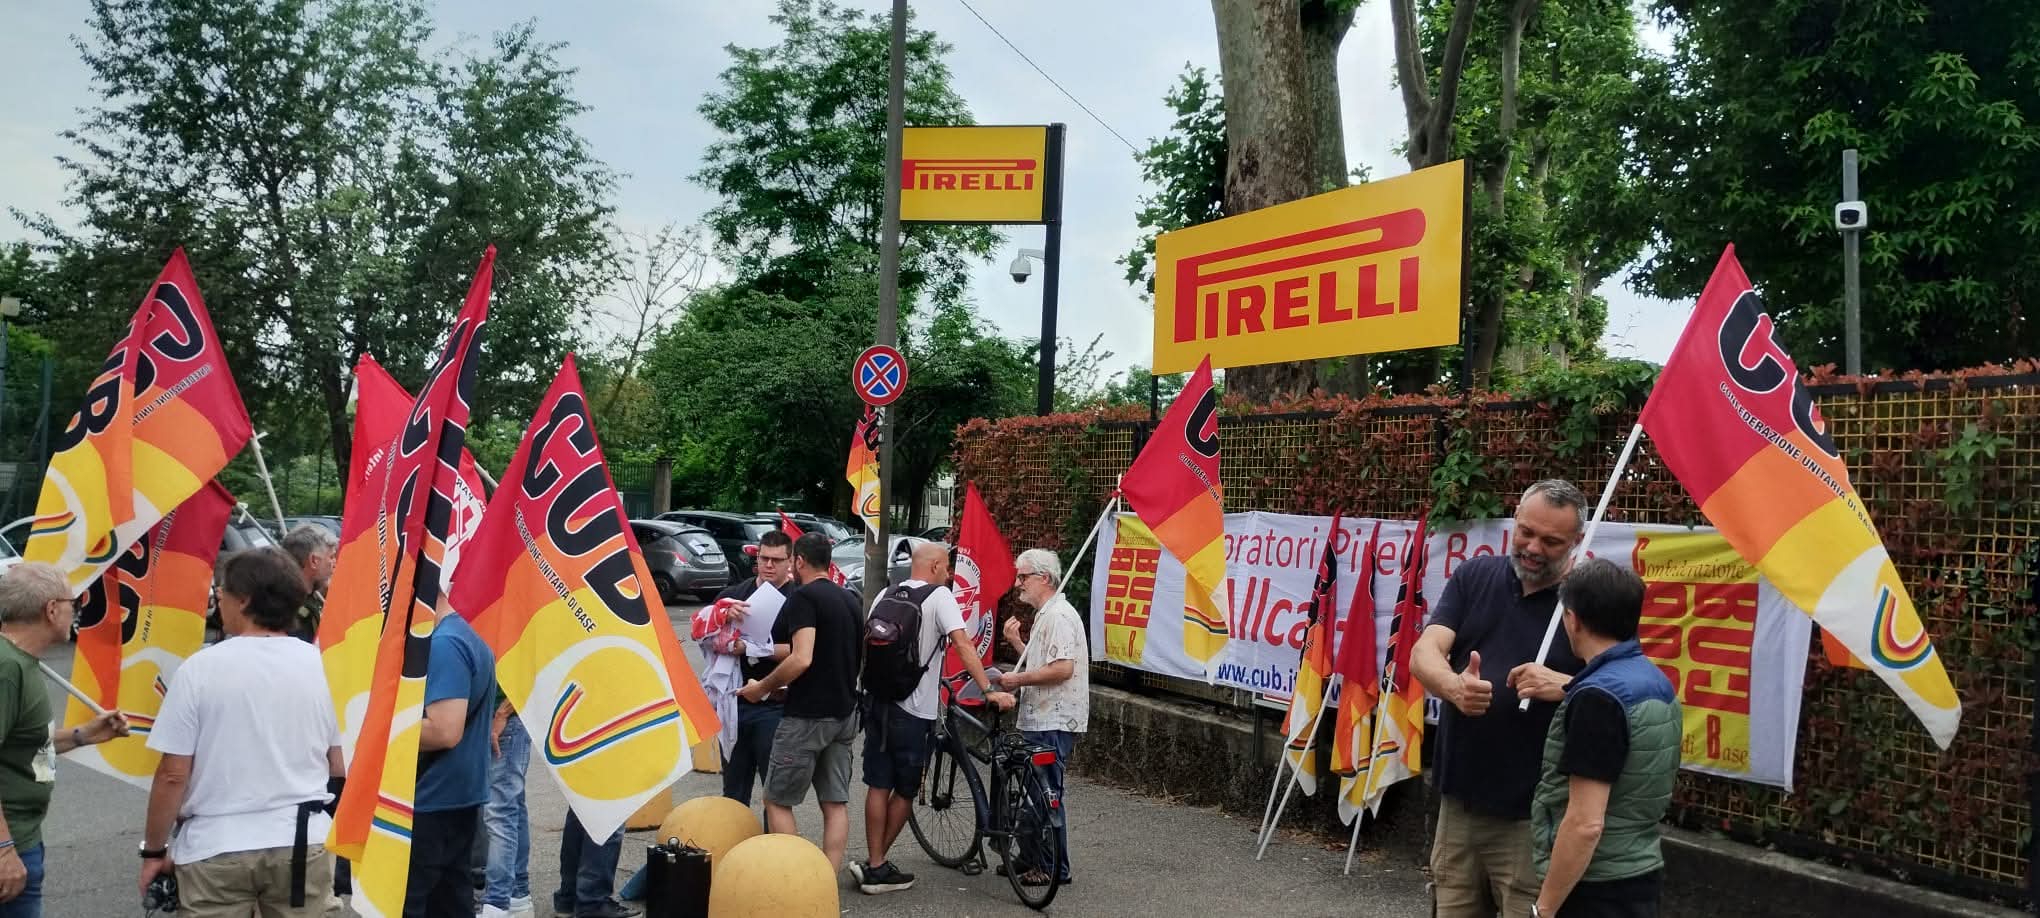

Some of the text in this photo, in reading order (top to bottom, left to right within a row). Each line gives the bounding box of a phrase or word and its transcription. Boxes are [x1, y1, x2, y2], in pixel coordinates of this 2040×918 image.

[901, 159, 1037, 190] PIRELLI
[1174, 207, 1427, 344] PIRELLI
[1718, 289, 1840, 458] CU
[1720, 382, 1801, 460] CONFEDERAZIONE
[1801, 456, 1846, 499] UNITARIA
[515, 500, 597, 633] CFEDERAZIONE UNITARIA DI BASE
[1225, 526, 1319, 570] oratori
[1335, 528, 1436, 578] Pieli
[1218, 663, 1297, 693] ww.cub.i
[1707, 714, 1748, 766] Base
